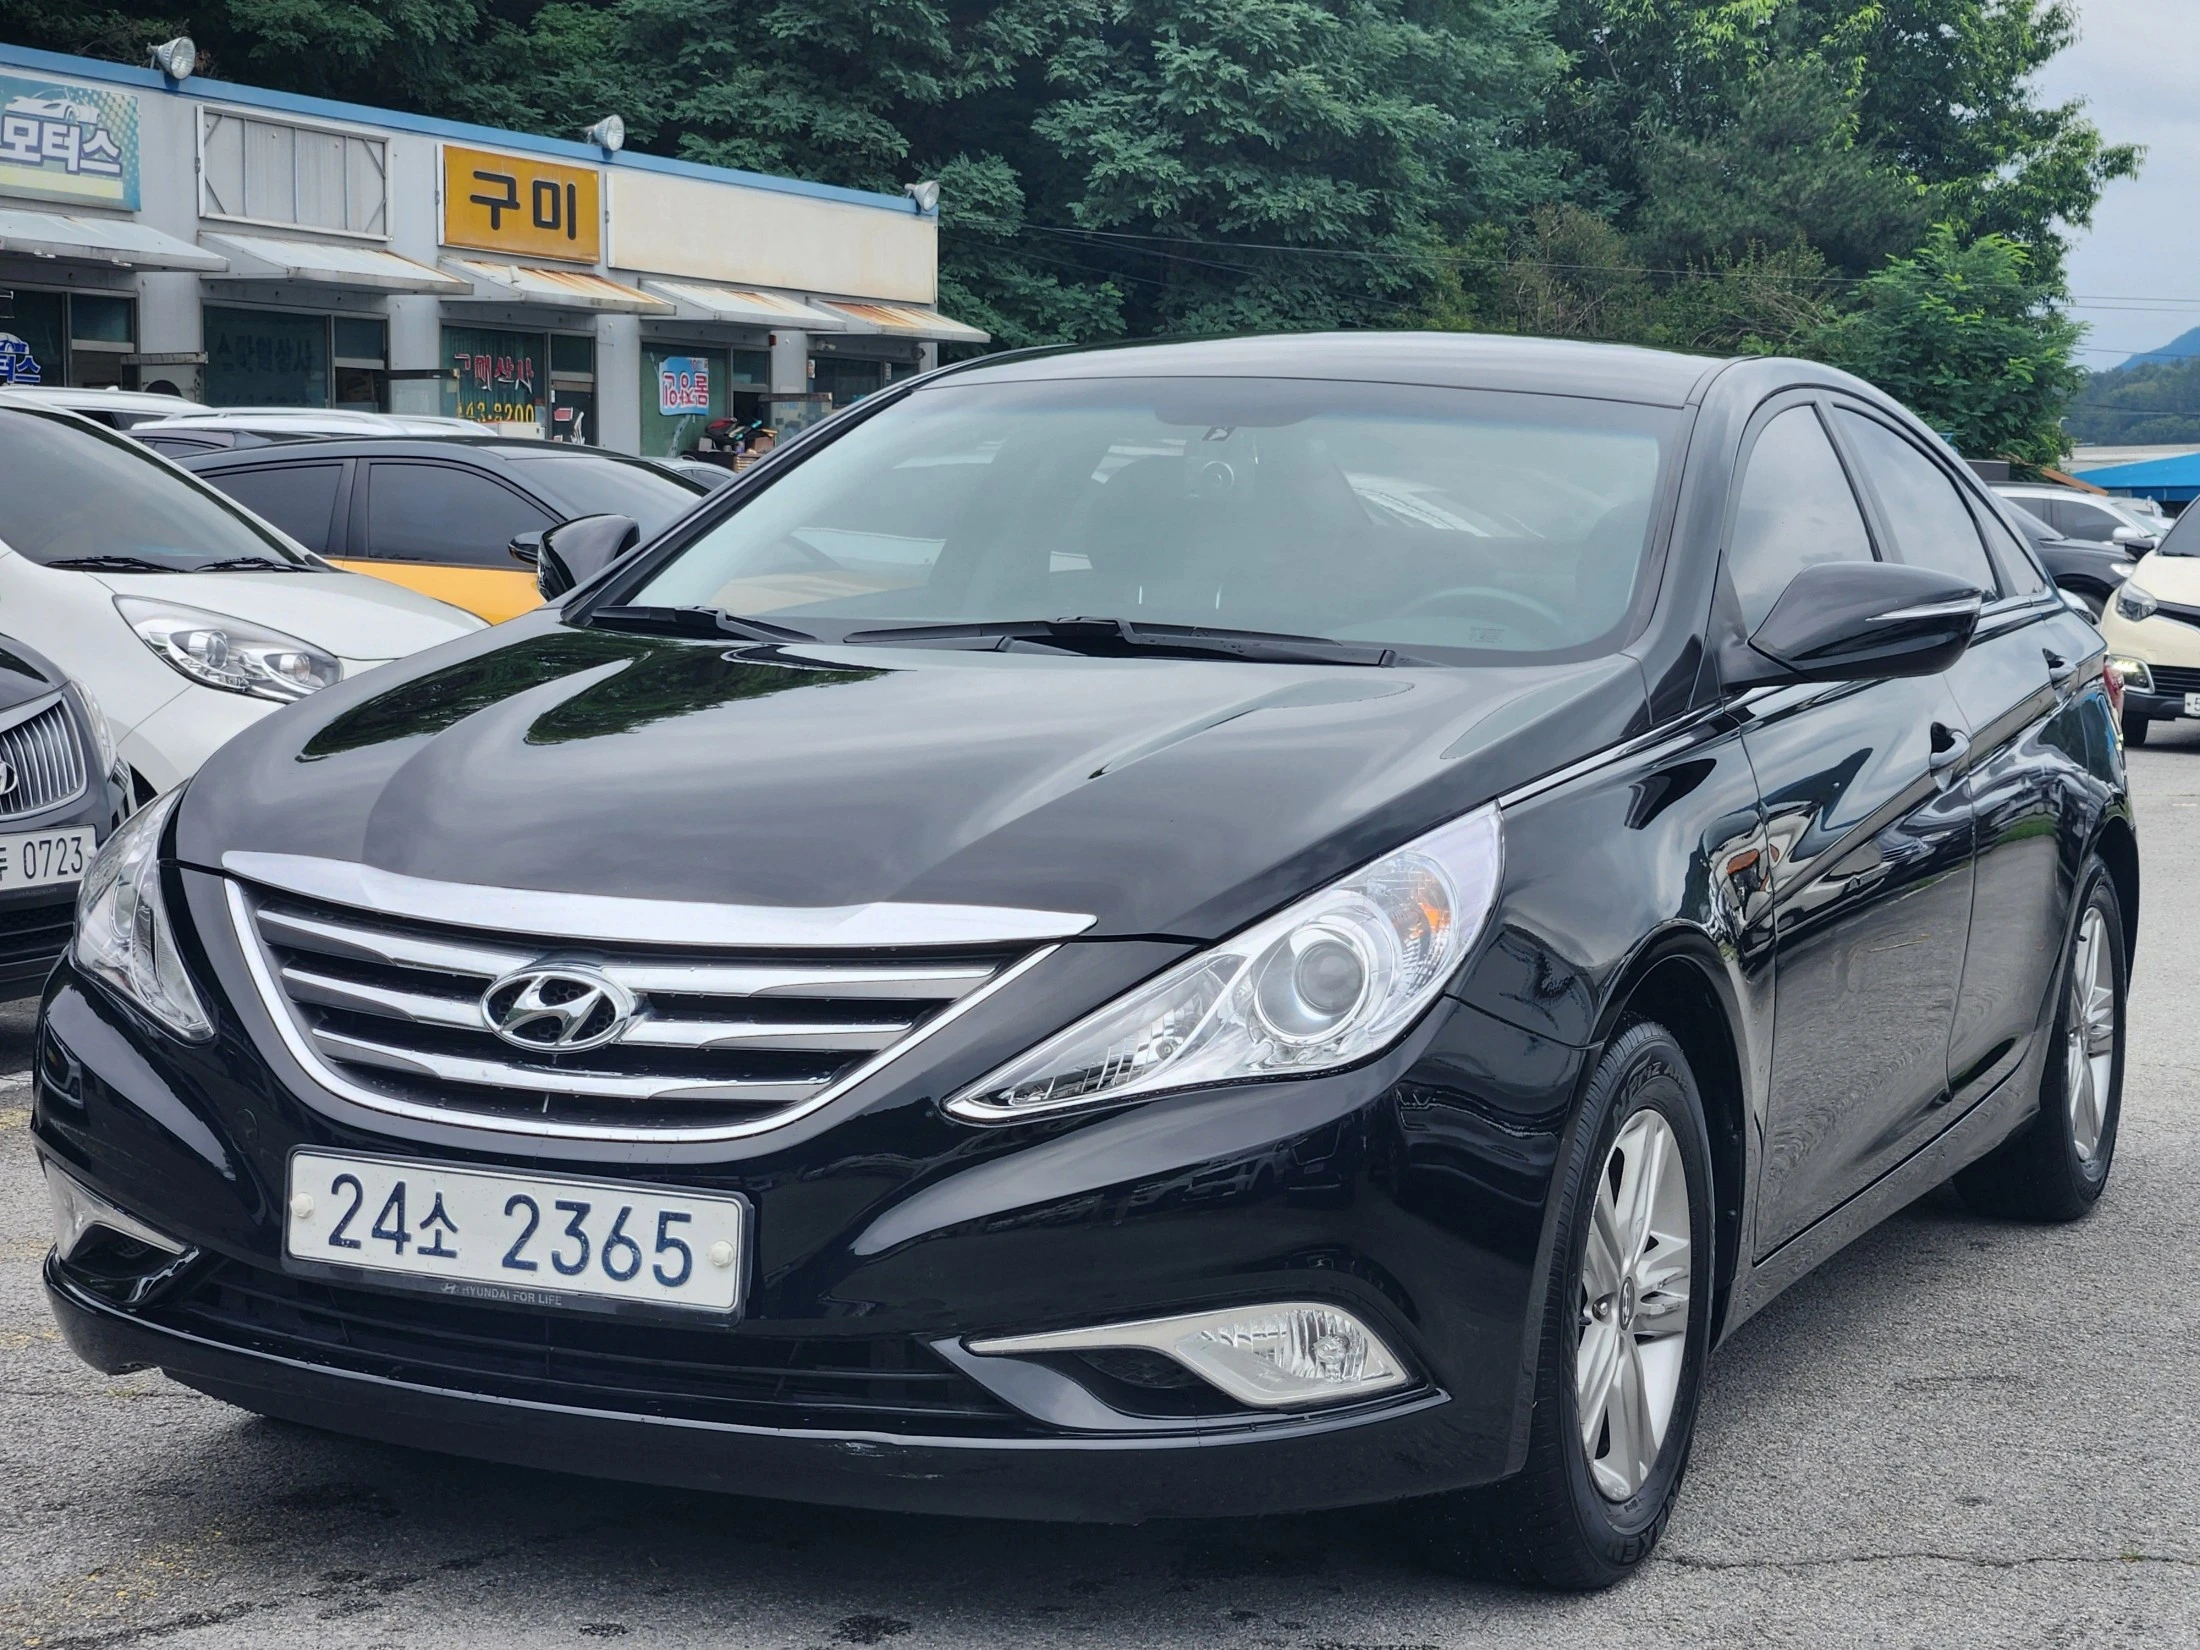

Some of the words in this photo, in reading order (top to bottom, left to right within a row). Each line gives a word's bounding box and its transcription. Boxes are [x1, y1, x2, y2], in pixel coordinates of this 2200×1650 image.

[0, 115, 122, 177] 모터스
[469, 170, 576, 240] 구미
[23, 836, 83, 879] 0723
[327, 1173, 459, 1258] 24소
[501, 1193, 693, 1287] 2365
[462, 1286, 510, 1300] HYUNDAI
[513, 1291, 535, 1303] FOR
[538, 1294, 562, 1306] LIFE
